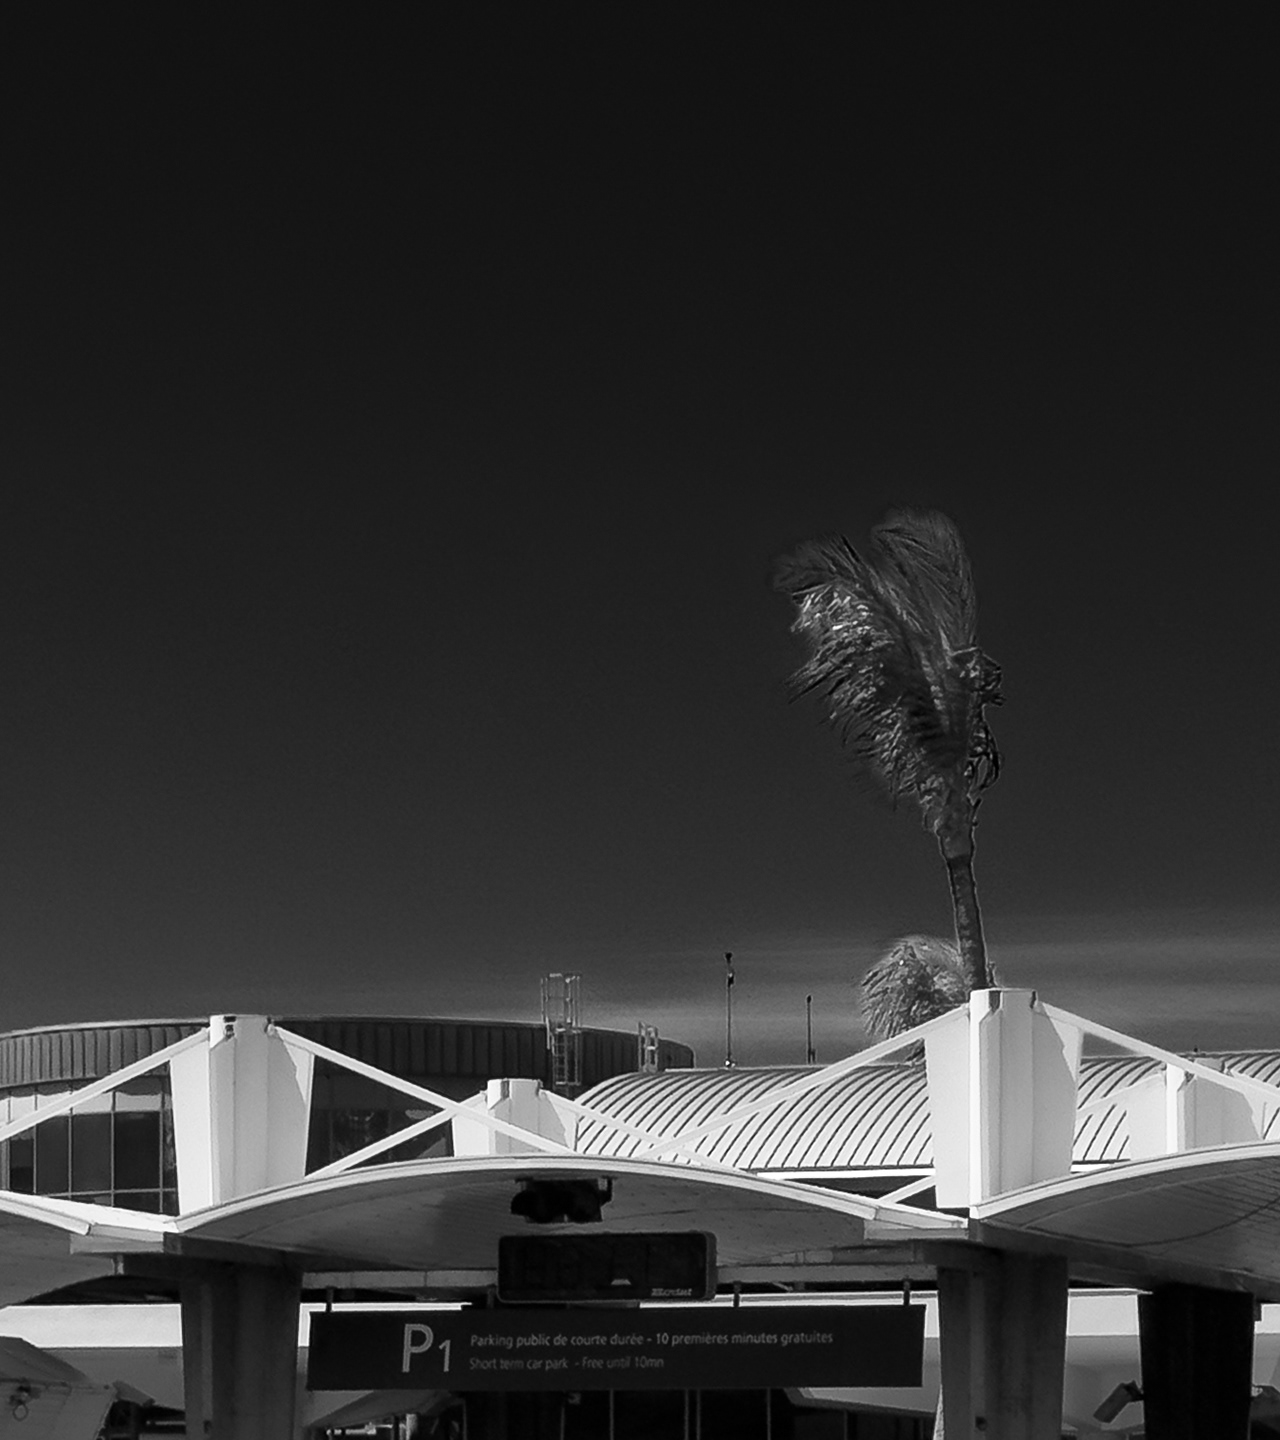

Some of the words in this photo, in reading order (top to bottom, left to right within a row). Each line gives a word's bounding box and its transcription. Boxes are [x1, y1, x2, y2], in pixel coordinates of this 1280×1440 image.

[401, 1323, 452, 1373] P1
[469, 1333, 513, 1350] Parking
[515, 1332, 551, 1350] public
[553, 1333, 568, 1346] de
[570, 1334, 607, 1346] courte
[609, 1332, 644, 1346] durée
[656, 1332, 669, 1345] 10
[671, 1331, 729, 1347] premières
[730, 1331, 778, 1345] minutes
[780, 1330, 834, 1347] gratuites
[468, 1356, 498, 1371] Short
[499, 1357, 524, 1370] term
[526, 1359, 543, 1370] car
[545, 1356, 568, 1372] park
[582, 1356, 604, 1369] Free
[606, 1356, 630, 1369] until
[634, 1355, 665, 1369] 10mn
